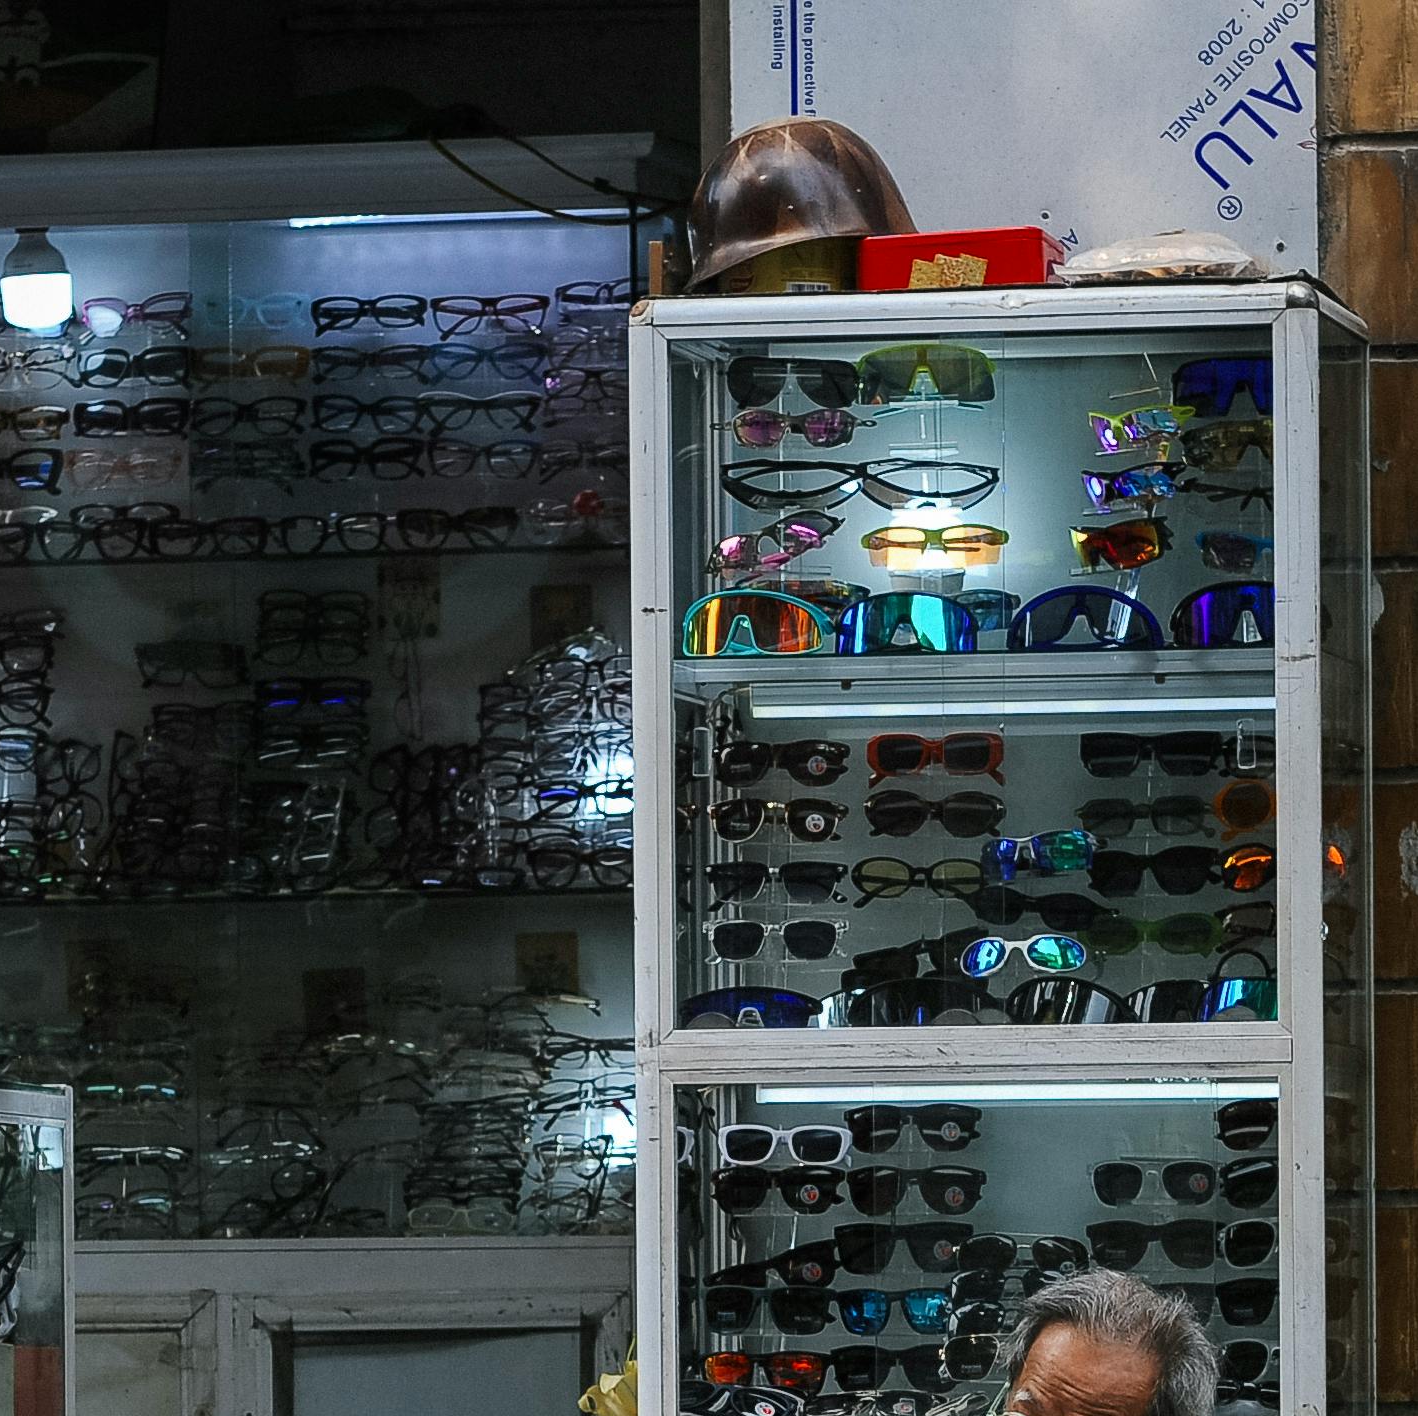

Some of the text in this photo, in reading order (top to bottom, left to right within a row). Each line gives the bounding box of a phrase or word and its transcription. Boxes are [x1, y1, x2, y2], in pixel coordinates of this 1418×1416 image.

[771, 4, 786, 70] installing
[803, 12, 816, 34] the
[1197, 18, 1243, 66] 2008
[802, 38, 817, 106] protective
[1159, 88, 1218, 143] PANEL
